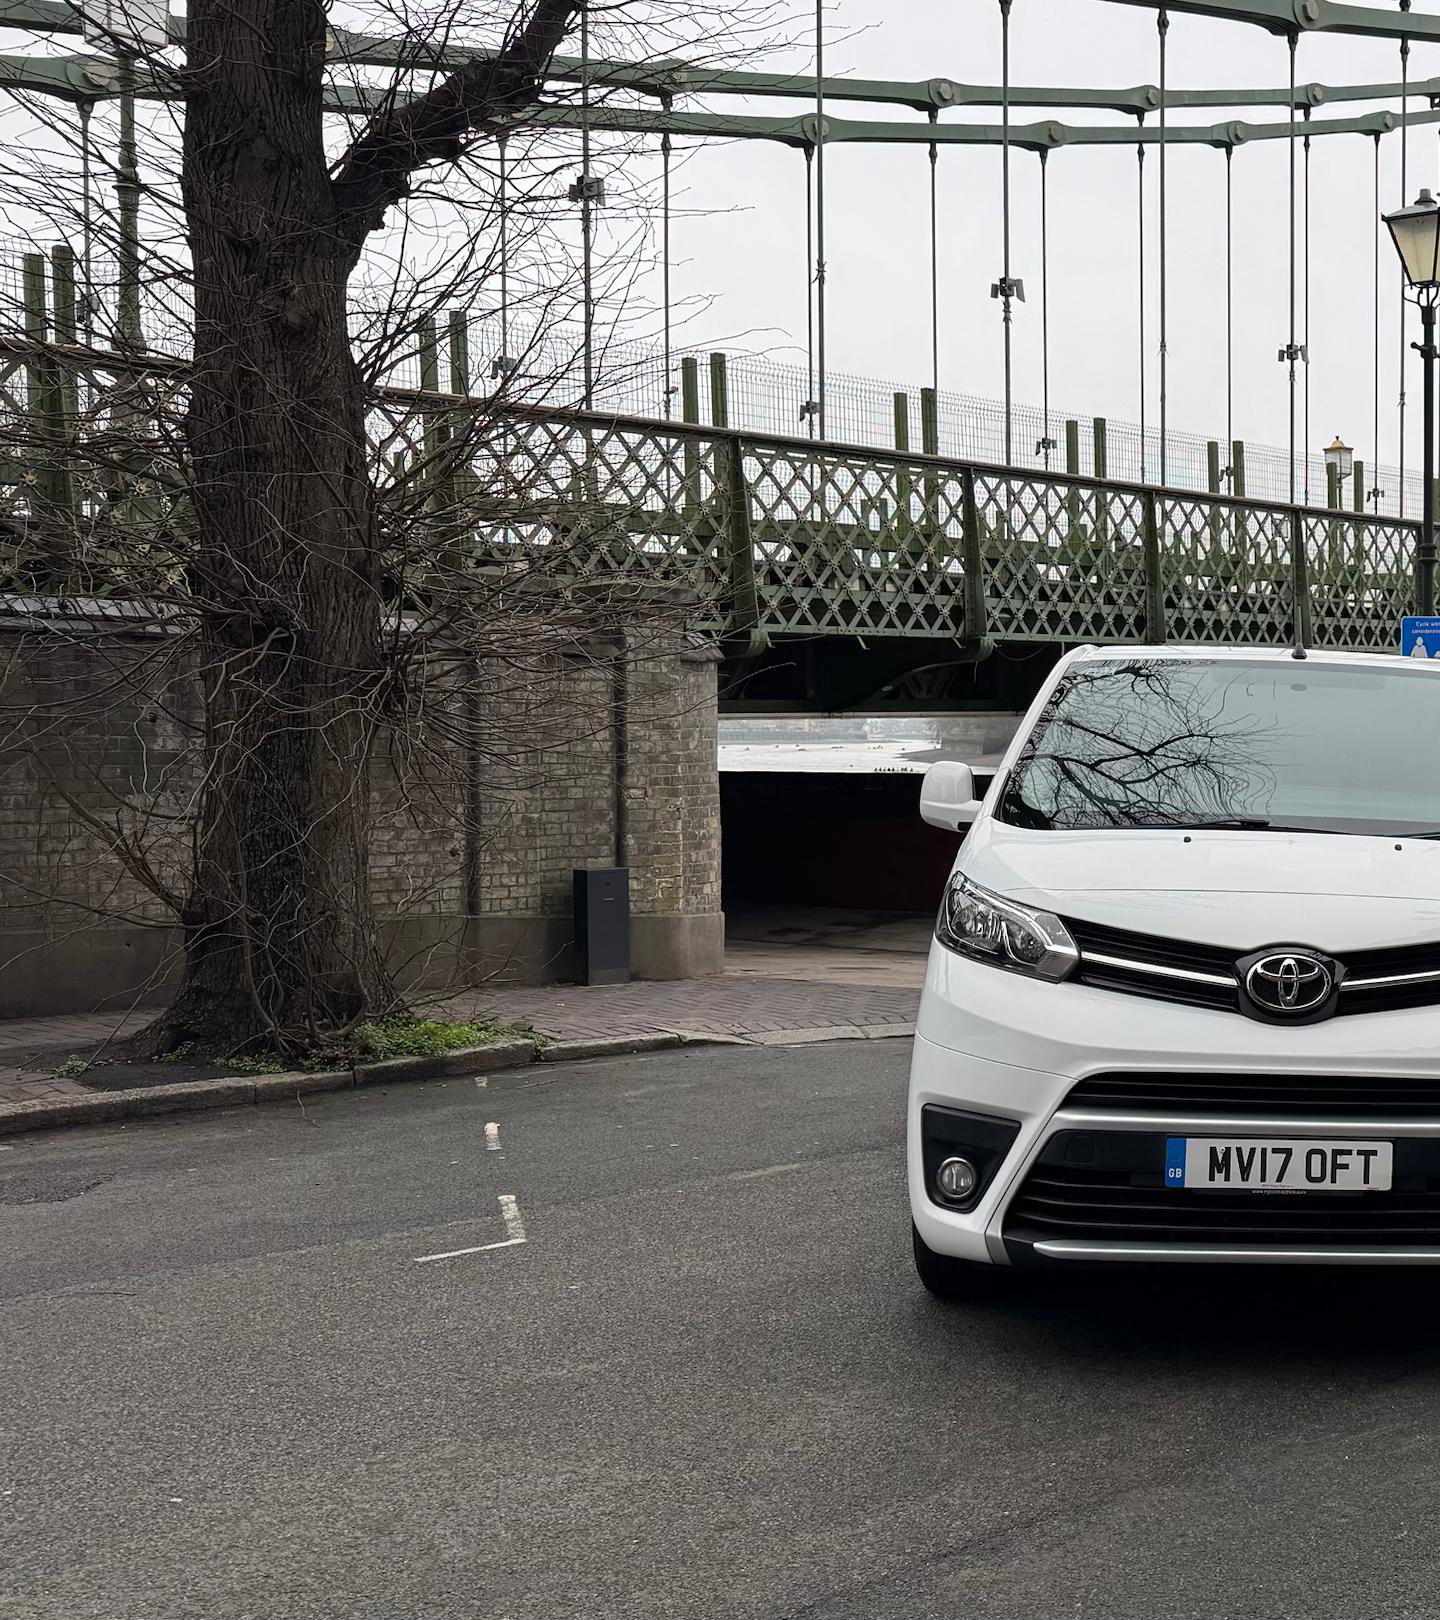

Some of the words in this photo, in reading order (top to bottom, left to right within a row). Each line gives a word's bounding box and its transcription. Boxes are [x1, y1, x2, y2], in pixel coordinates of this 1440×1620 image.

[1168, 1167, 1182, 1179] GB
[1208, 1146, 1293, 1183] MV17
[1305, 1147, 1379, 1185] OFT
